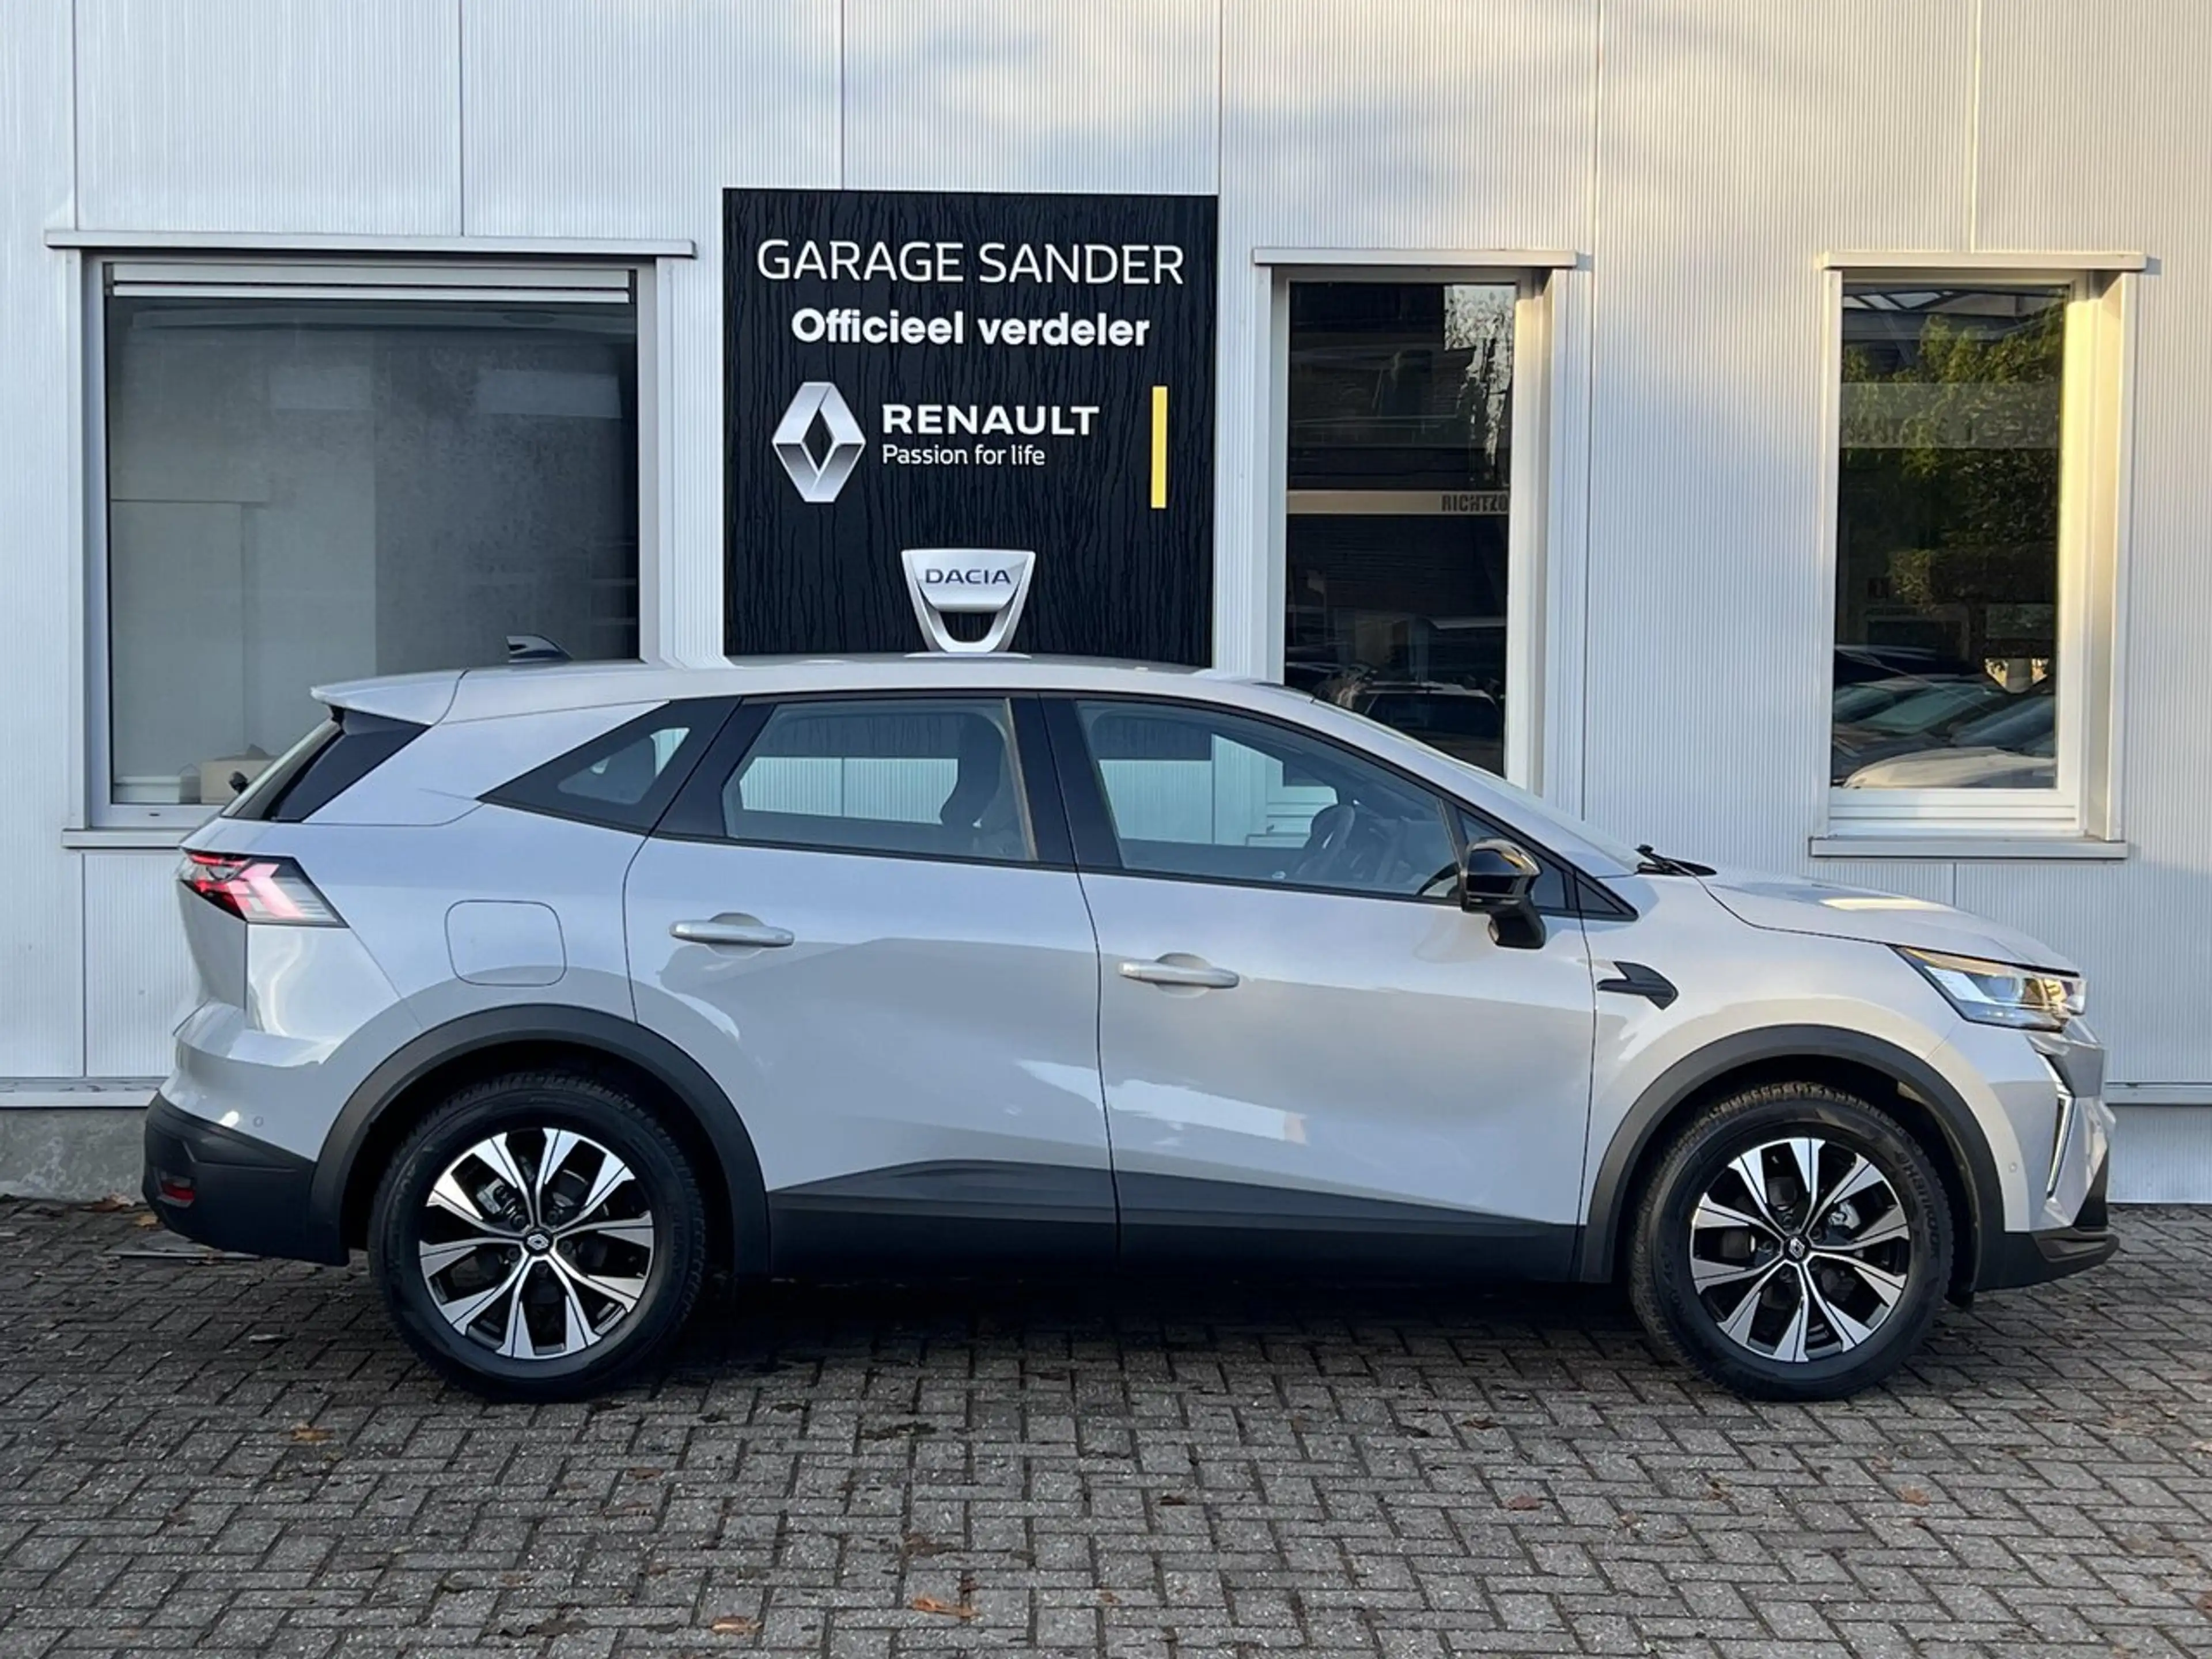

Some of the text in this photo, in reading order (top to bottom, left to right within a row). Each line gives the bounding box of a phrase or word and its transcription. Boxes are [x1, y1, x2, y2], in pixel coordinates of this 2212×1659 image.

[757, 239, 1183, 285] GARAGE SANDER
[791, 308, 1150, 346] Officieel verdeler
[882, 404, 1100, 435] RENAULT
[882, 444, 1045, 465] Passion for life
[925, 569, 1012, 585] DACIA
